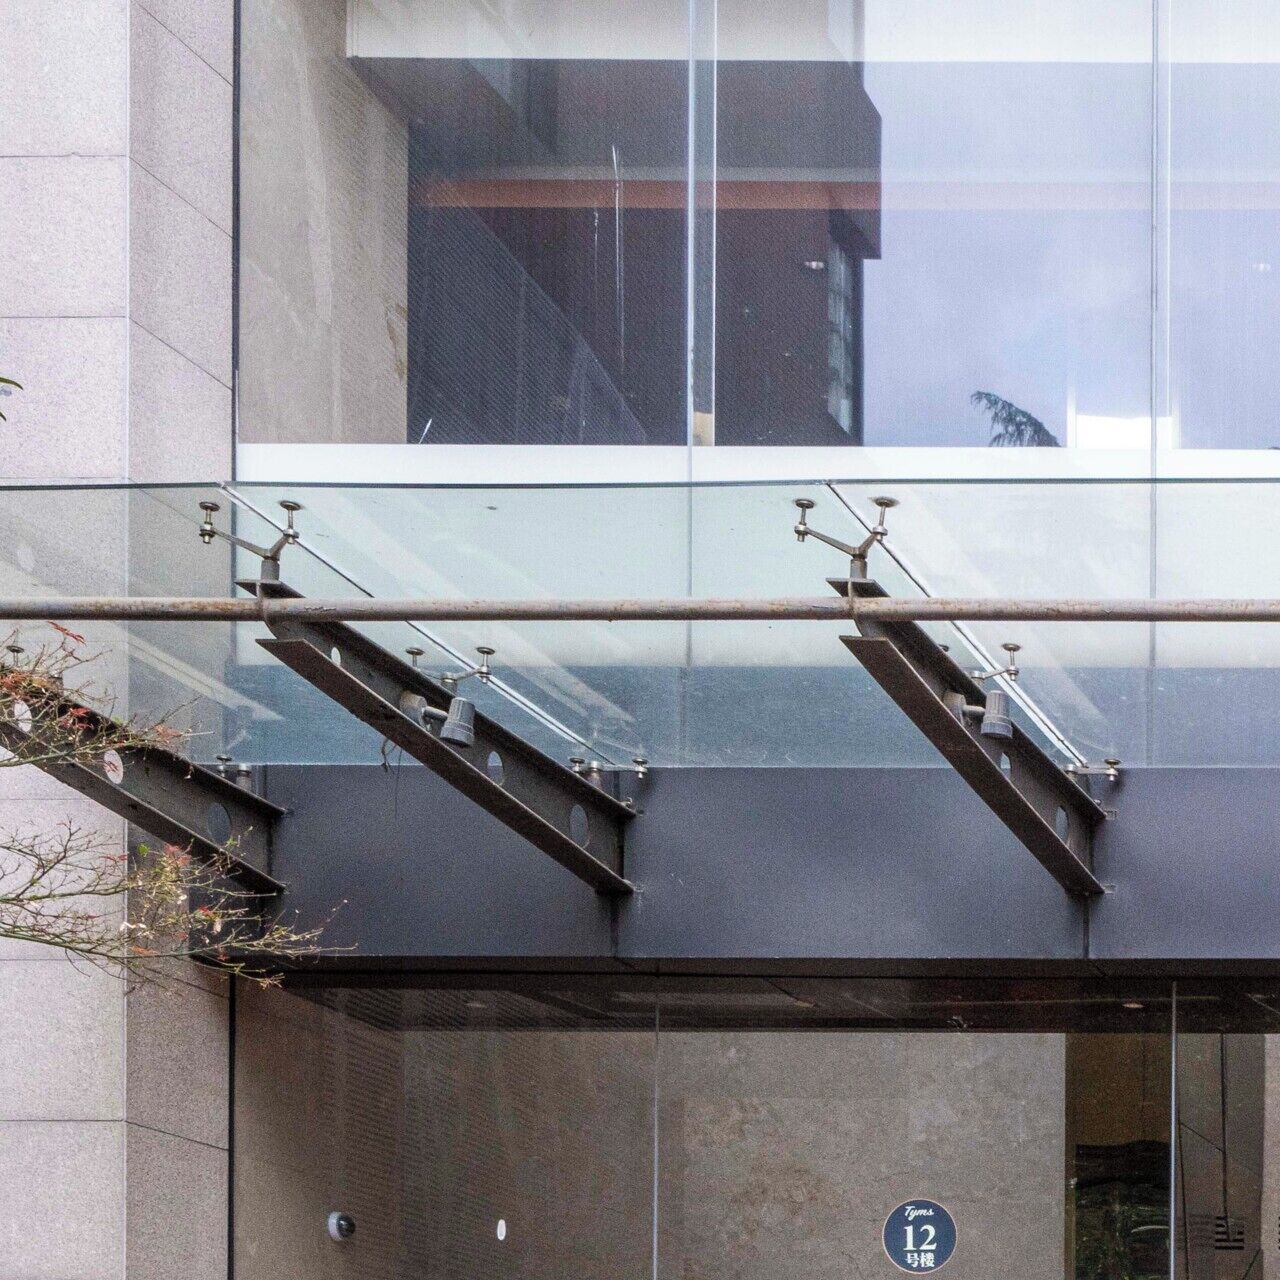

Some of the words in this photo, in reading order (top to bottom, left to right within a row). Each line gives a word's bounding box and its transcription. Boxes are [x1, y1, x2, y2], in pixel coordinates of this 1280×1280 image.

[904, 1205, 935, 1221] Tyms
[903, 1224, 937, 1251] 12
[905, 1252, 935, 1268] 号楼
